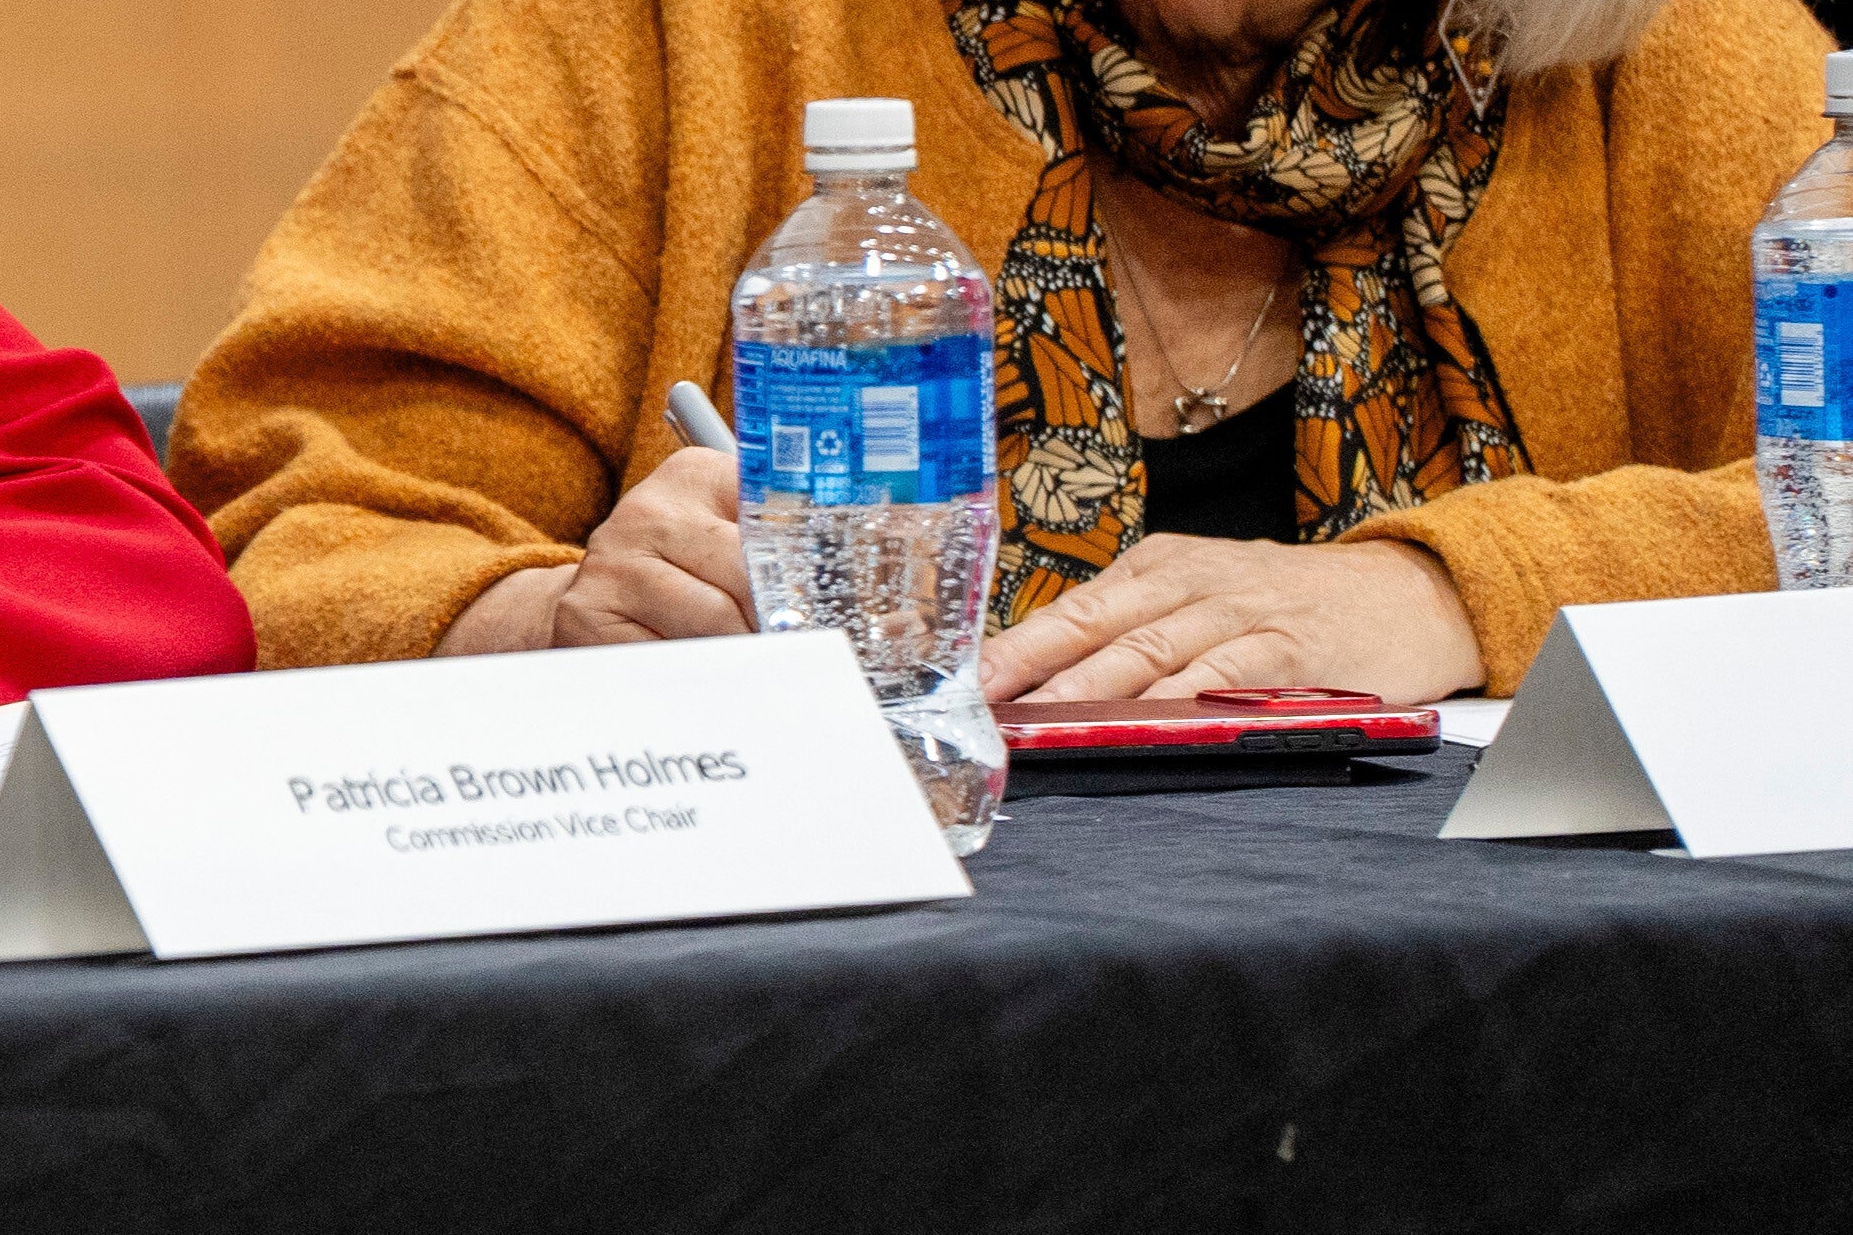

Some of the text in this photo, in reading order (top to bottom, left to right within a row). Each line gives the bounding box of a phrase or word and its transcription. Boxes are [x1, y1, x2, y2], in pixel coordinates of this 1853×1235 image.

[770, 348, 849, 370] AQUAFINA
[287, 748, 747, 814] Patricia Brown Holmes
[385, 803, 698, 853] Commission Vice Chair
